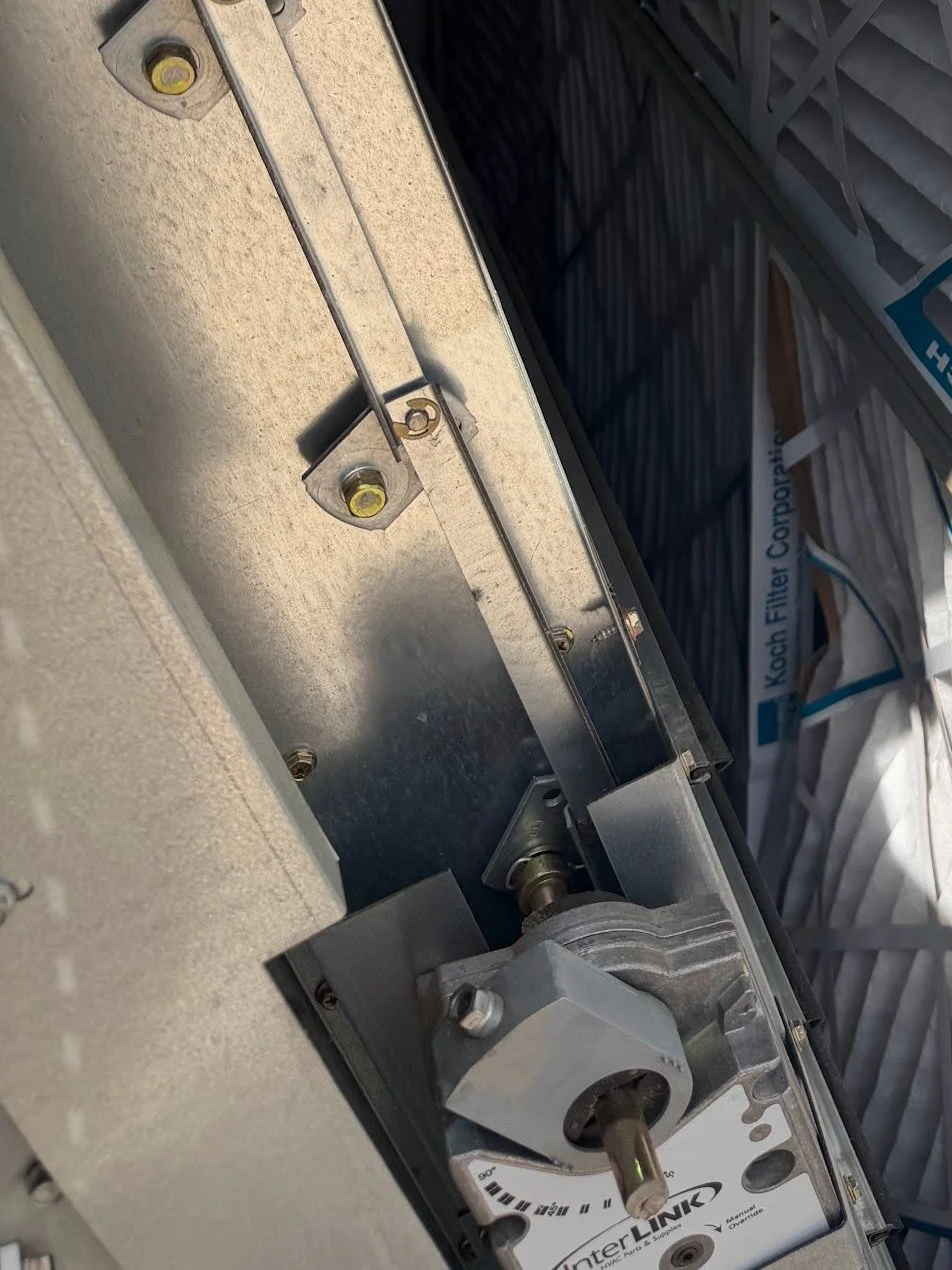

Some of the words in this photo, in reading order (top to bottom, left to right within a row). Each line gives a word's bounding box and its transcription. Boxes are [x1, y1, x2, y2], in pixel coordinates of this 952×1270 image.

[765, 566, 789, 626] Filter
[764, 629, 788, 690] Koch
[725, 1203, 757, 1225] Manual
[728, 1208, 764, 1230] Override
